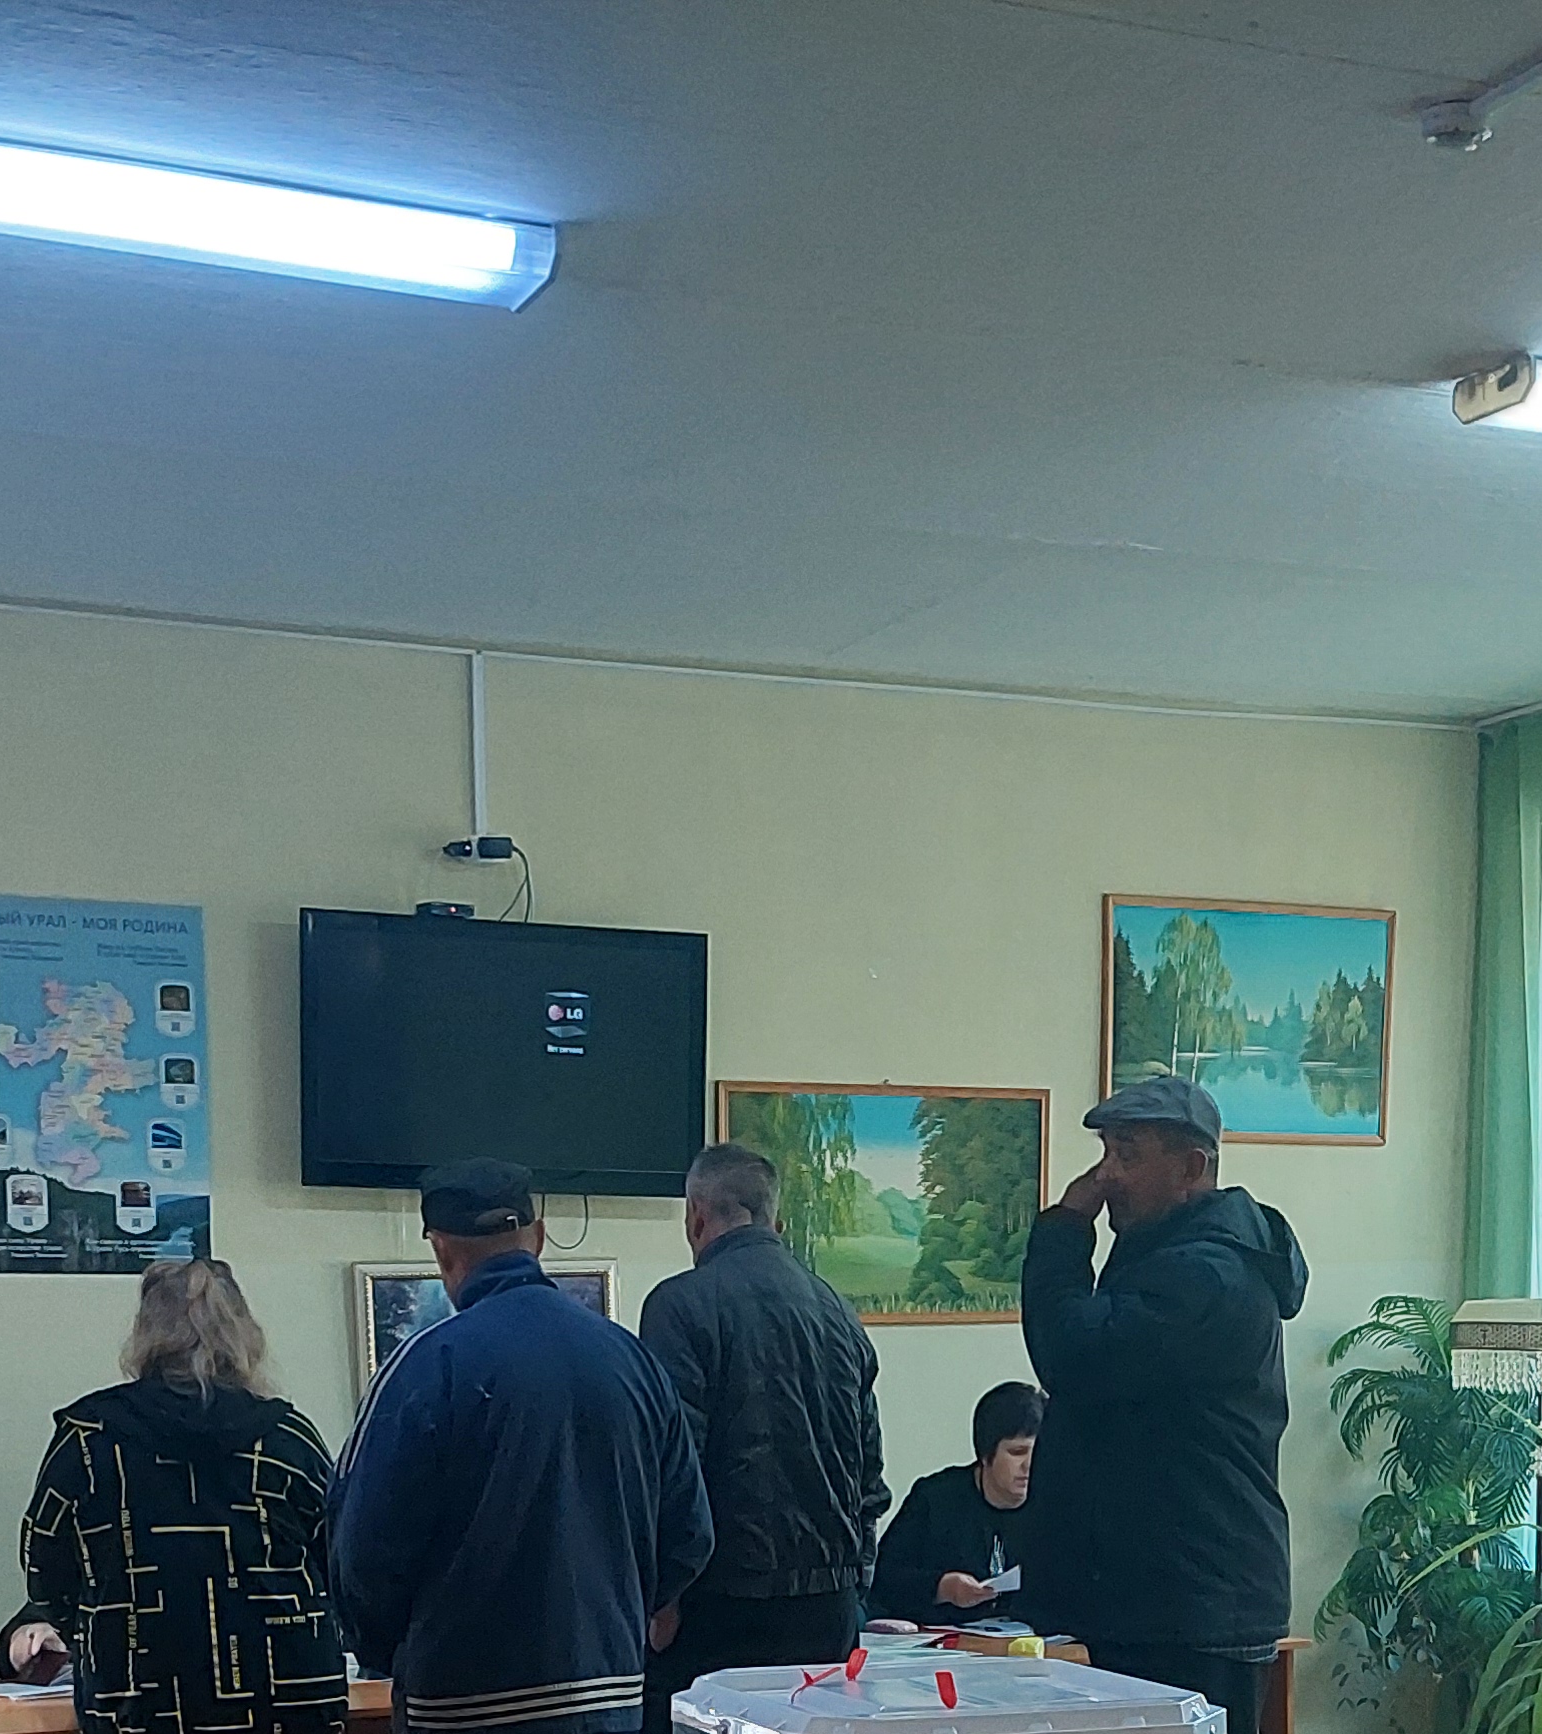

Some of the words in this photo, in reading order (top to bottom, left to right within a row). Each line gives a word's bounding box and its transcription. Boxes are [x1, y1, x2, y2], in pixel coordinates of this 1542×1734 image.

[27, 914, 67, 929] УРАЛ
[82, 917, 118, 931] МОЯ
[123, 919, 189, 936] РОДИНА
[566, 1007, 583, 1020] LG
